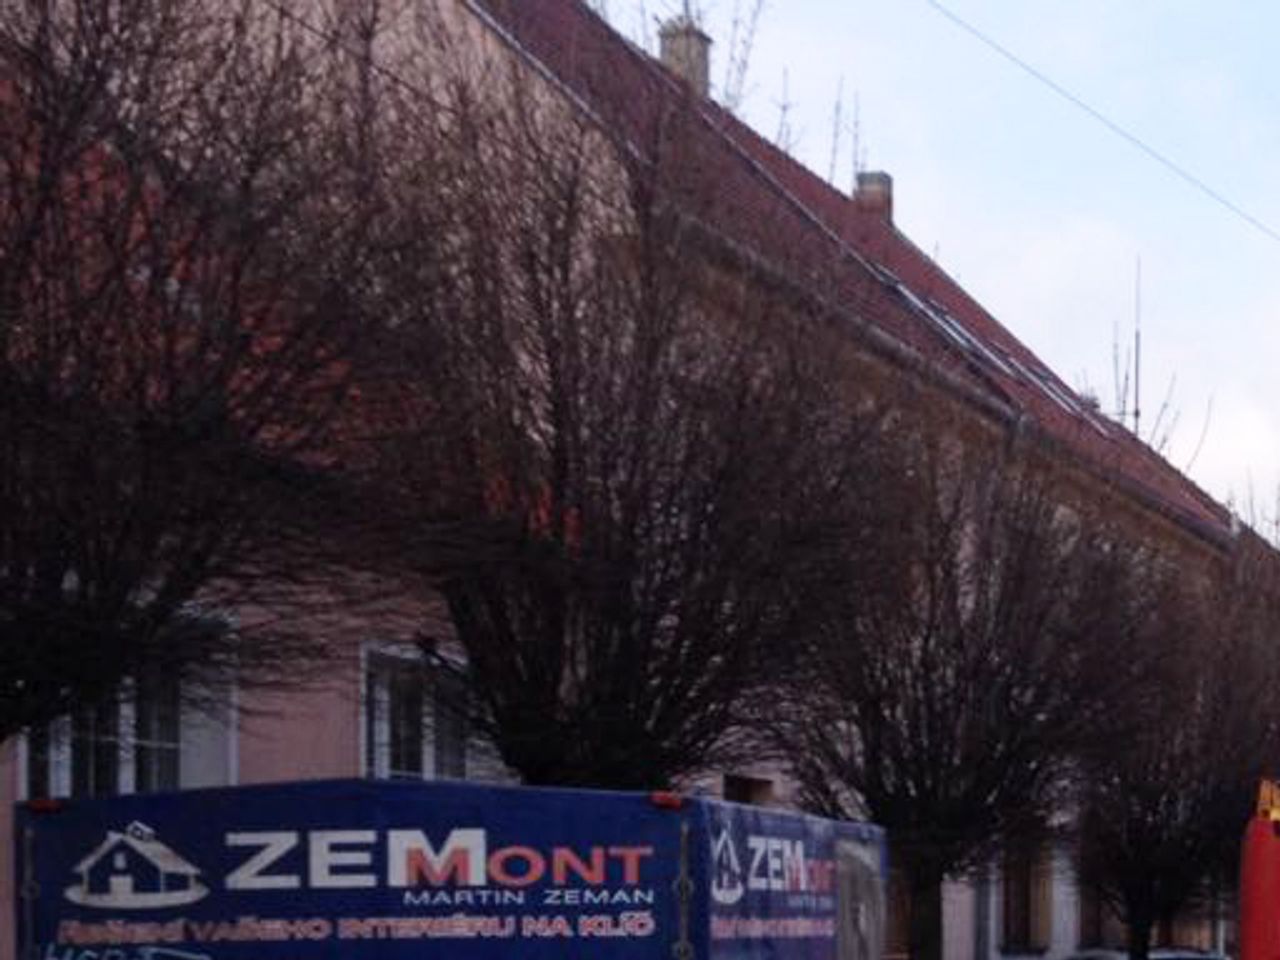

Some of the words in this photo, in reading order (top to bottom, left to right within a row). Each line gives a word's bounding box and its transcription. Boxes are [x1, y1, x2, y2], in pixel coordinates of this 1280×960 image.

[402, 890, 524, 906] MARTIN
[543, 889, 654, 905] ZEMAN
[521, 915, 573, 938] NA
